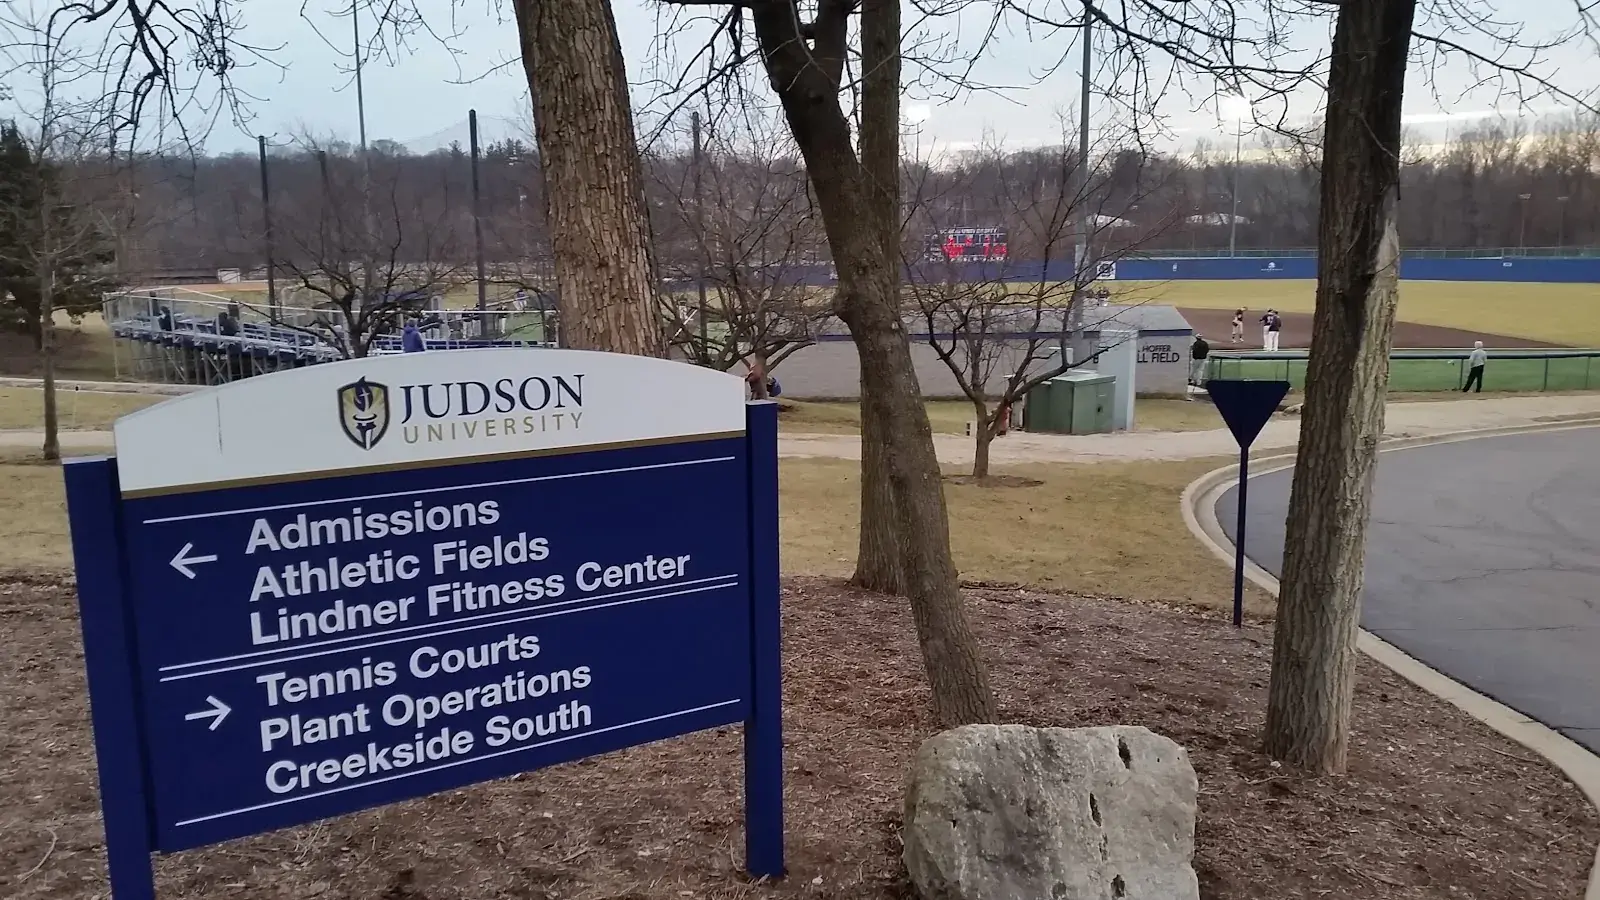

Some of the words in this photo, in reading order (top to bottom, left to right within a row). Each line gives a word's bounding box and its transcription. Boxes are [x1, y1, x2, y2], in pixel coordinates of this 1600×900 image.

[1151, 353, 1180, 363] FIELD
[400, 374, 585, 424] JUDSON
[403, 412, 583, 444] UNIVERSITY
[244, 499, 500, 555] Admissions
[249, 549, 421, 602] Athletic
[433, 532, 550, 575] Fields
[251, 597, 416, 646] Lindner
[427, 575, 566, 617] Fitness
[575, 554, 691, 592] Center
[255, 657, 397, 707] Tennis
[409, 633, 541, 679] Courts
[259, 703, 372, 753] Plant
[381, 665, 592, 728] Operations
[265, 726, 475, 795] Creekside
[485, 700, 592, 747] South
